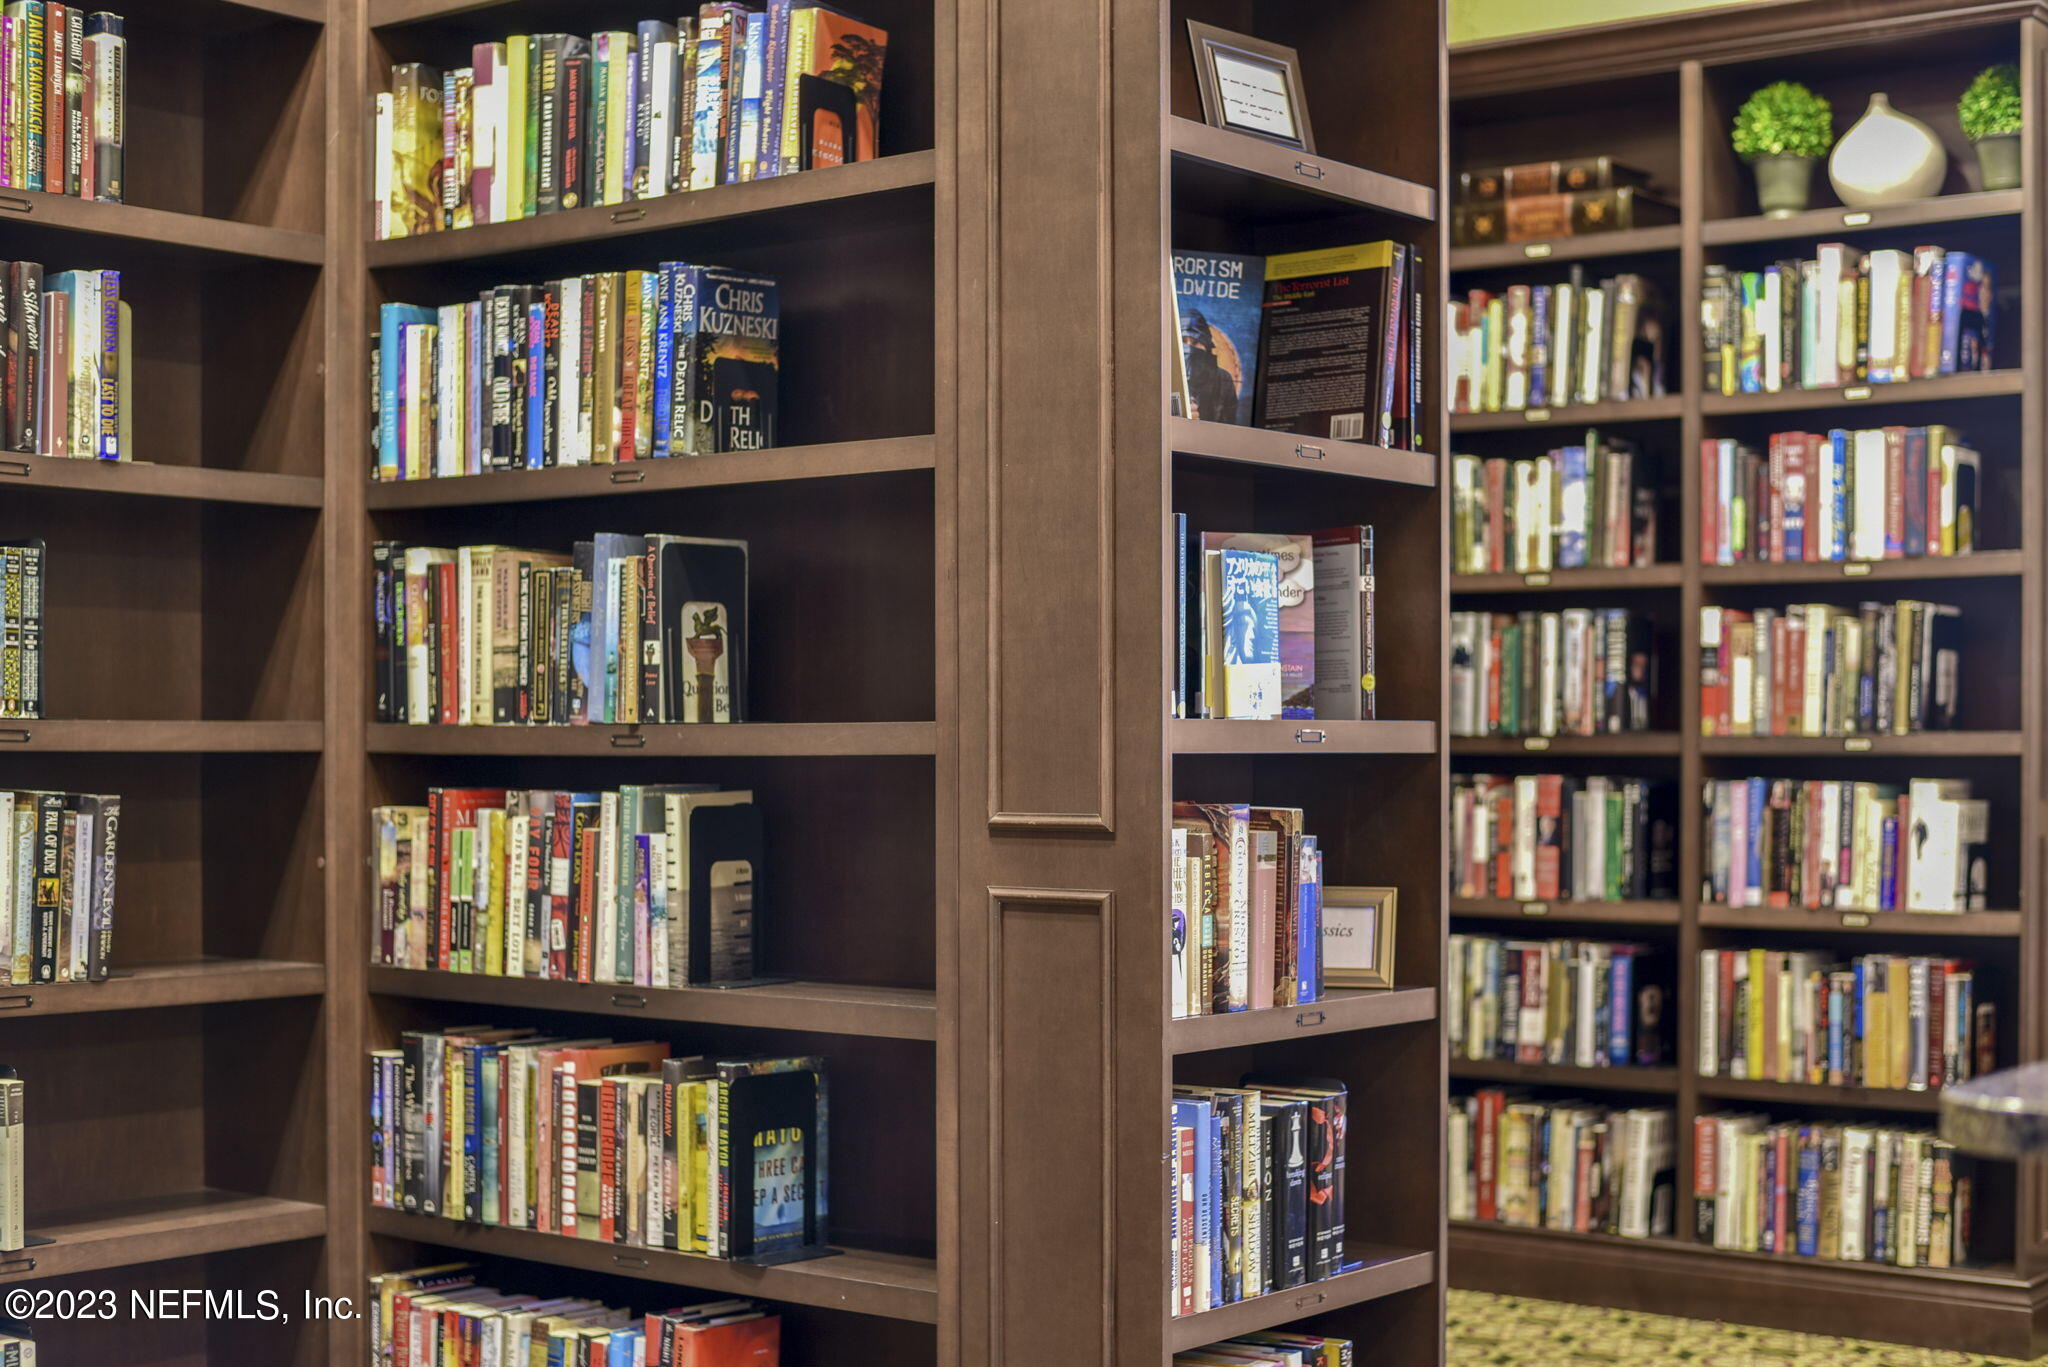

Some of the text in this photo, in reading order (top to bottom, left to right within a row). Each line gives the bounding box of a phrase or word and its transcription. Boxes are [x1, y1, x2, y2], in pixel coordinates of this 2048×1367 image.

[54, 31, 62, 53] JANET
[70, 17, 83, 71] CATEGORY 7
[641, 33, 650, 82] moonrise
[765, 4, 779, 82] Barbara Kingsolver
[28, 13, 43, 135] JANET EVANOVICH
[51, 56, 62, 96] EVANOVICH
[543, 59, 556, 90] KERR
[569, 69, 577, 89] MARK
[720, 62, 729, 82] KING
[789, 27, 804, 142] BARBARA KINGSOLVER
[543, 103, 553, 120] MAN
[568, 102, 576, 117] THE
[569, 91, 577, 101] OF
[542, 122, 552, 156] WITHOUT
[760, 89, 774, 154] Flight Behavior
[28, 139, 37, 177] SPOOKY
[35, 146, 43, 172] PLUM
[541, 158, 552, 189] BREATH
[1174, 256, 1243, 279] RORISM
[1333, 276, 1350, 287] List
[673, 273, 686, 333] KUZNESKI
[682, 284, 695, 321] CHRIS
[715, 284, 764, 314] CHRIS
[1175, 278, 1241, 300] LDWIDE
[1391, 277, 1400, 296] The
[103, 277, 118, 353] TESS GERRITSEN
[550, 303, 560, 338] DEAN
[640, 279, 651, 380] JAYNE ANN KRENTZ
[658, 270, 669, 379] JAYNE ANN KRENTZ
[699, 306, 778, 339] KUZNESKI
[529, 371, 537, 397] MASK
[622, 376, 635, 411] GREAT
[675, 360, 687, 401] DEATH
[102, 378, 115, 437] LAST TO DIE
[493, 377, 510, 426] COLD FIRE
[544, 376, 556, 453] Odd Apocalypse
[621, 418, 634, 450] HOUSE
[673, 405, 686, 438] RELIC
[646, 554, 656, 588] Question
[646, 601, 656, 625] Belief
[647, 590, 656, 600] of
[519, 578, 528, 686] THE VIEW FROM THE TOWER
[559, 603, 569, 684] THUNDERSTRUCK
[44, 811, 59, 874] PAUL OF DUNE
[603, 803, 611, 892] DEBBIE MACOMBER
[101, 815, 118, 929] GARDEN EVIL
[528, 846, 540, 891] FOUR
[573, 851, 583, 884] LIONS
[619, 795, 631, 952] DEBBIE MACOMBER Starting Now
[512, 839, 523, 963] JEWEL BRET LOTT
[1323, 922, 1354, 938] ssics
[405, 1065, 415, 1092] The
[649, 1109, 657, 1146] PEOPLE
[664, 1083, 672, 1136] RUNAWAY
[719, 1081, 728, 1167] ARCHER MAYOR
[601, 1084, 615, 1177] TIGHTROPE
[1246, 1112, 1258, 1178] MELTZER
[754, 1157, 786, 1178] HREE
[1264, 1155, 1272, 1201] SON
[664, 1159, 672, 1221] PETER MAY
[1230, 1195, 1240, 1236] SECRETS
[1181, 1237, 1187, 1249] OF
[1246, 1212, 1258, 1273] SHADOW
[1288, 1240, 1304, 1249] MEYER
[1316, 1233, 1332, 1241] MEYER
